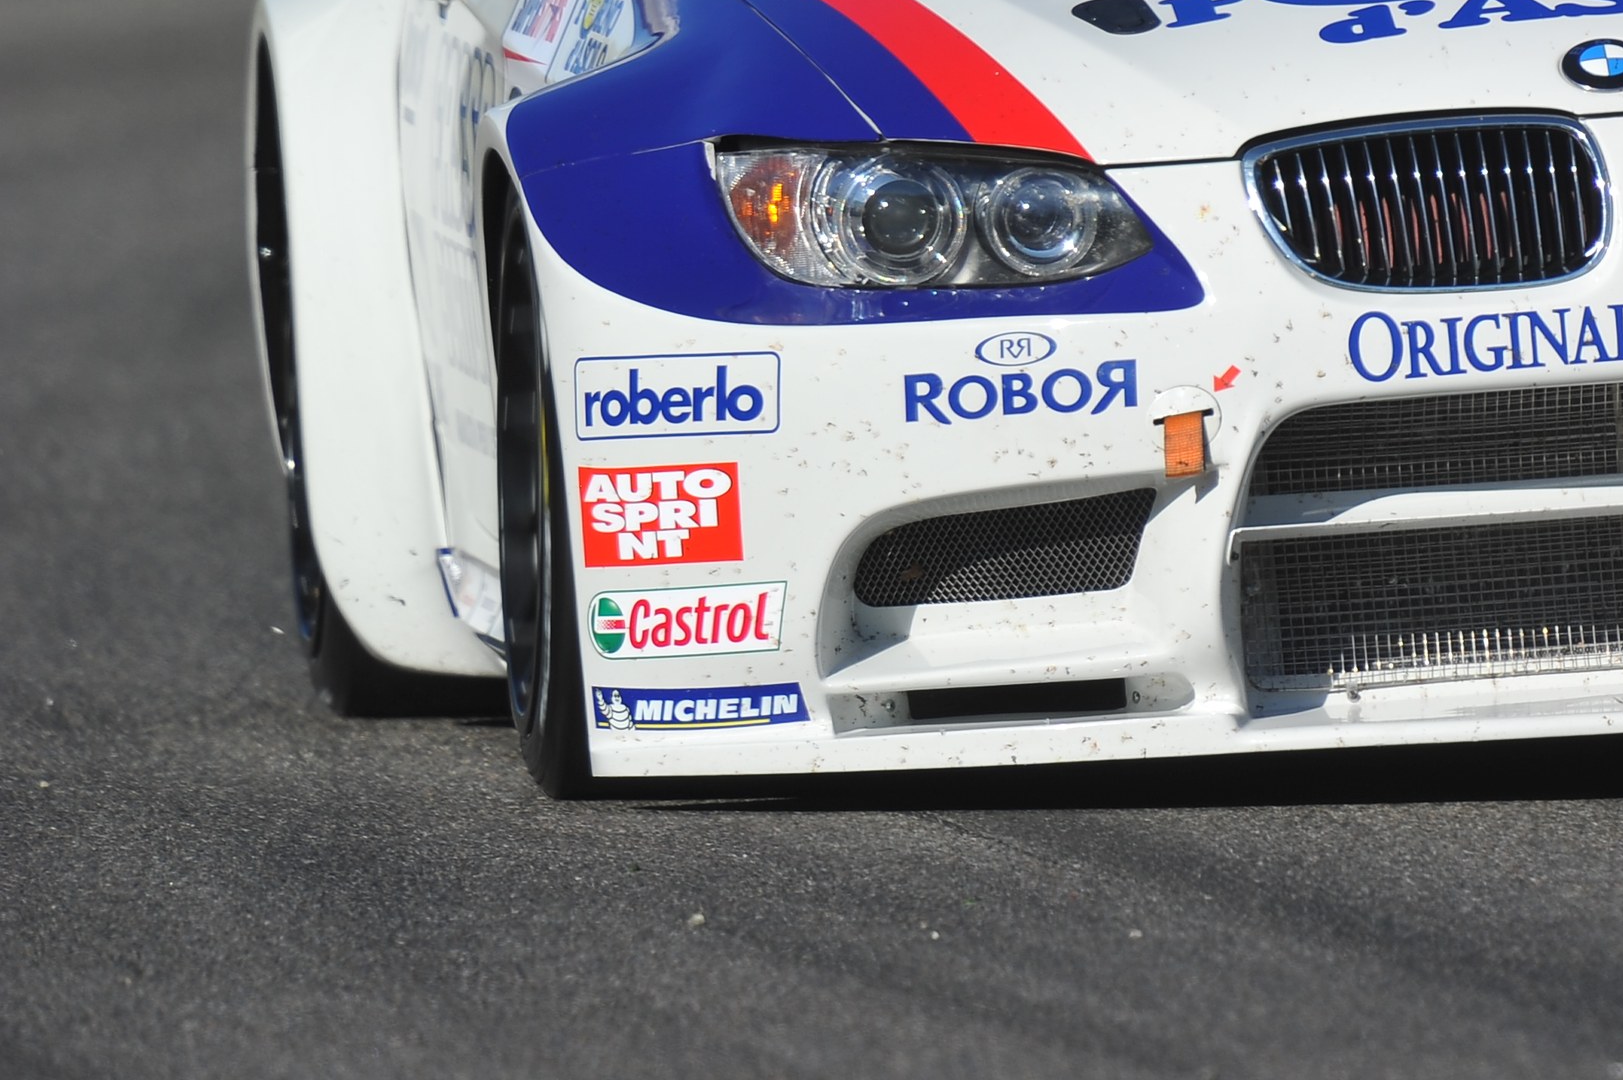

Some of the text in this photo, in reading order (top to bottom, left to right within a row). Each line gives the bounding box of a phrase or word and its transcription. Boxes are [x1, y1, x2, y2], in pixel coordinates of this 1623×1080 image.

[584, 365, 764, 427] roberlo
[585, 468, 732, 503] AUTO
[591, 497, 719, 533] SPRI
[618, 528, 690, 560] NT
[628, 591, 770, 650] Castrol
[634, 693, 799, 722] MICHELIN
